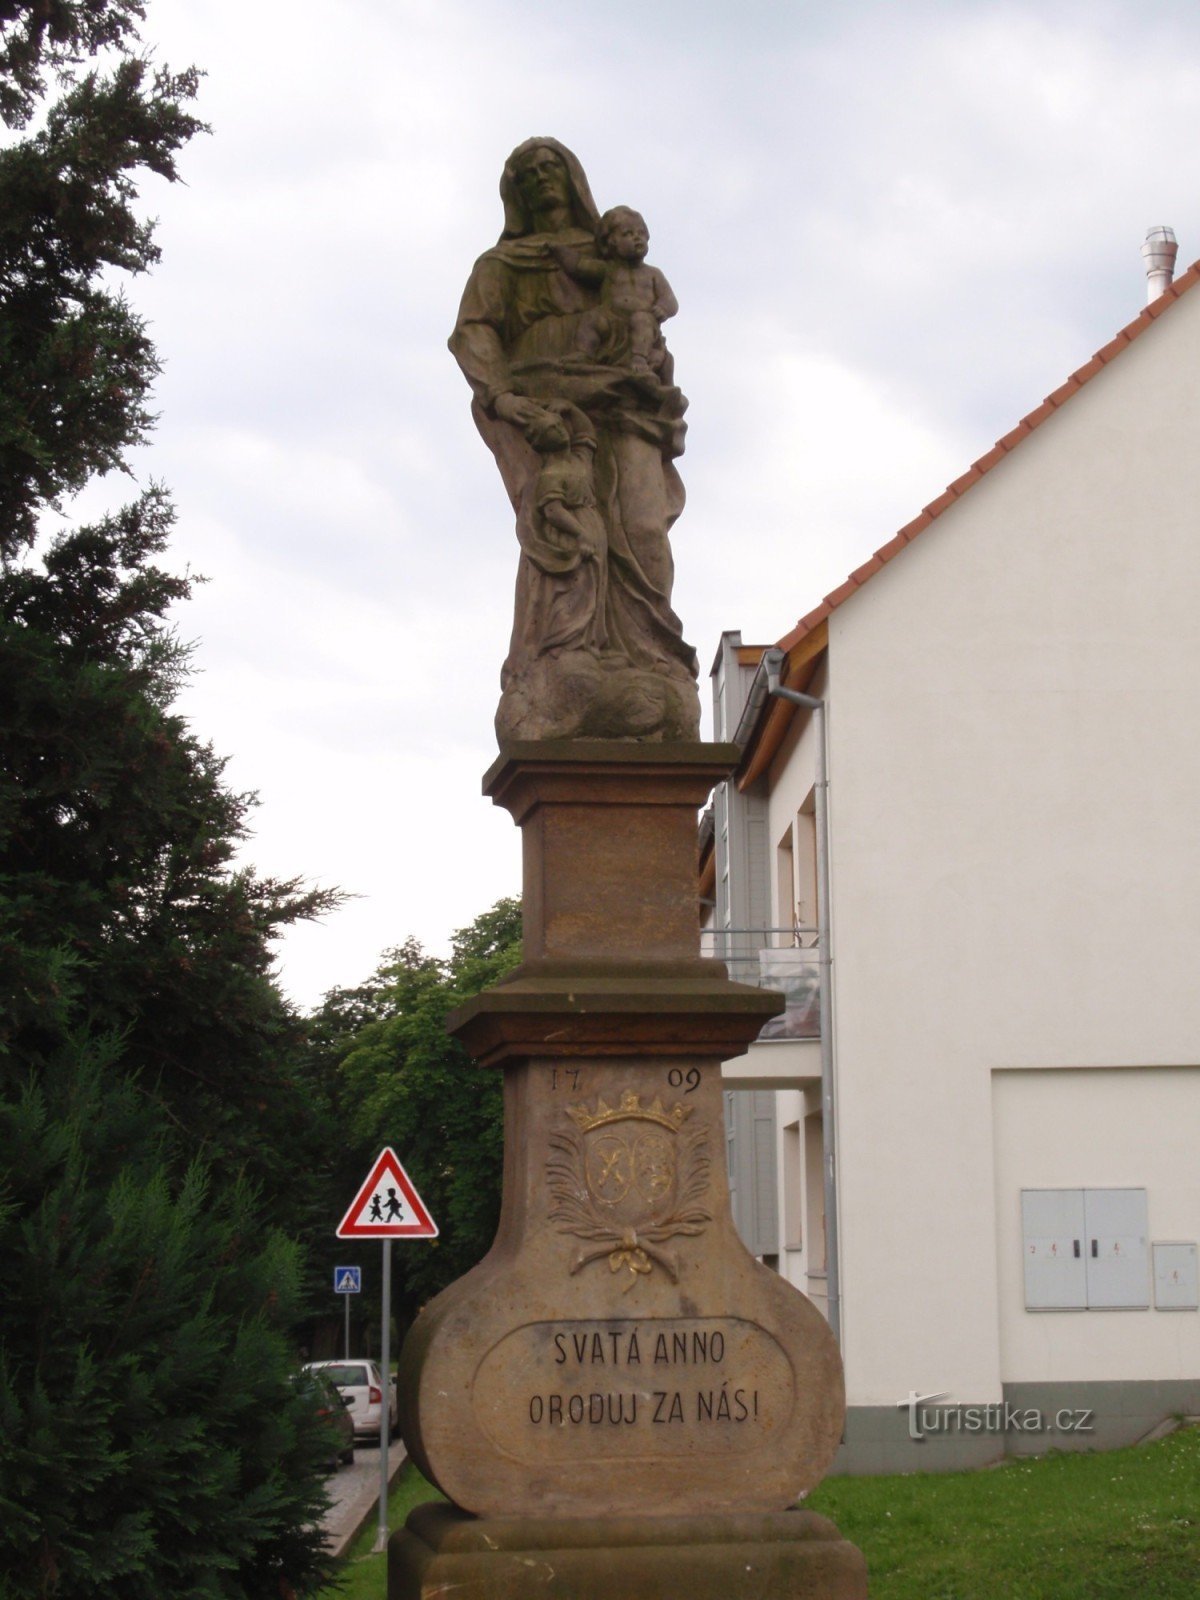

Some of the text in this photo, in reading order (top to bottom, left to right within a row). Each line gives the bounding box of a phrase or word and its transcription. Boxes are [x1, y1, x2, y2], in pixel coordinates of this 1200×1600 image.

[552, 1067, 701, 1095] 17 09
[554, 1327, 725, 1365] SVATÁ ANNO
[529, 1381, 758, 1425] ORODUJ ZA NÁS!
